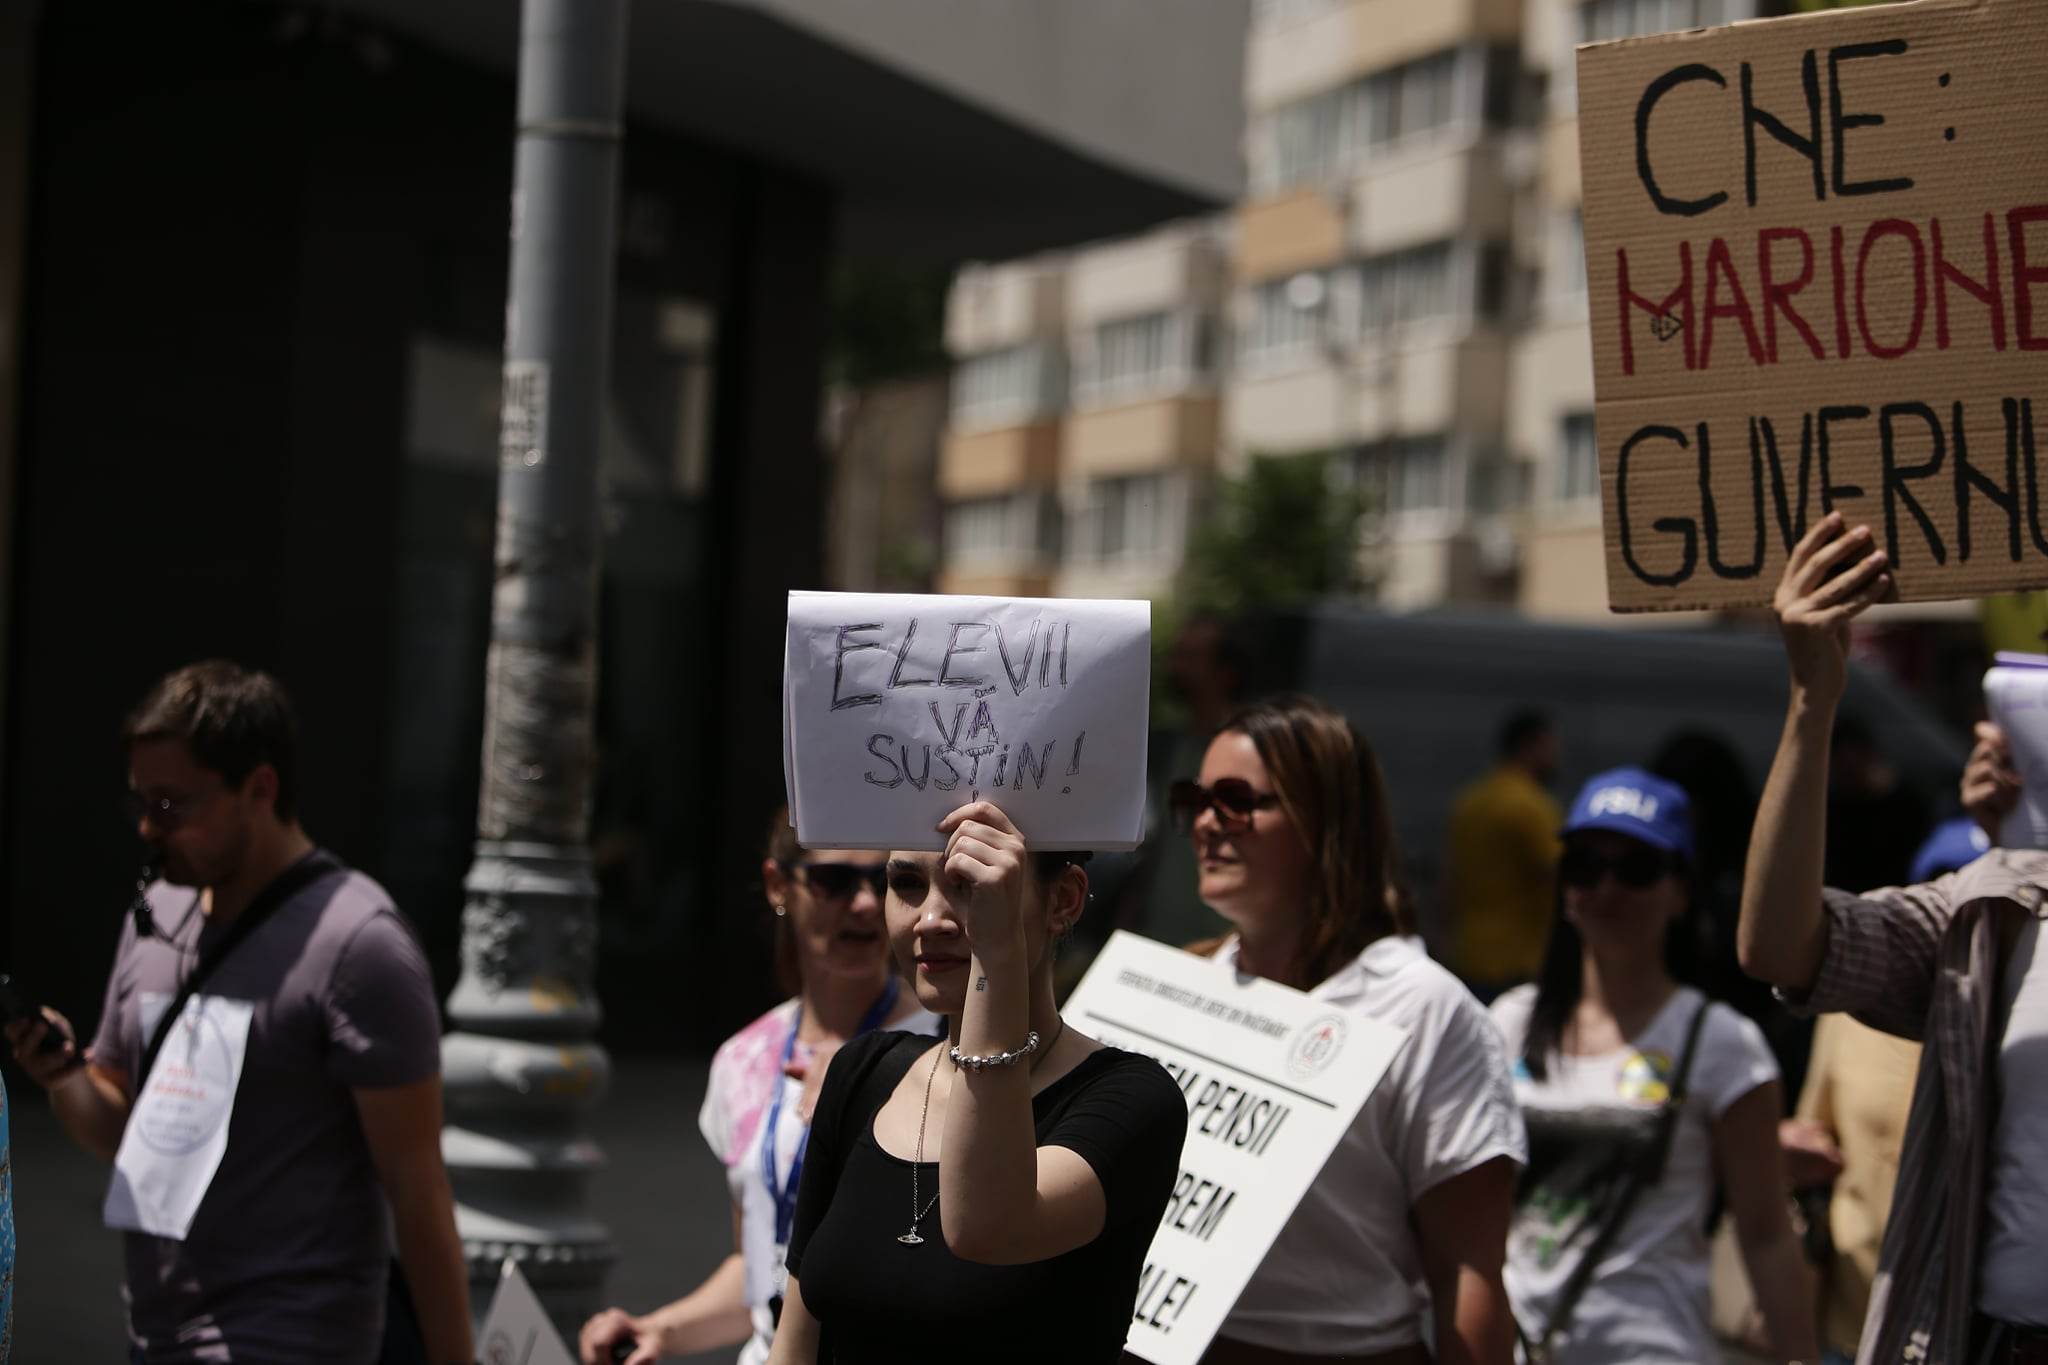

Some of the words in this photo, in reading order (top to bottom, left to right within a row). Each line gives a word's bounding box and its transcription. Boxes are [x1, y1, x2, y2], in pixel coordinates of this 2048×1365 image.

[832, 617, 1070, 711] ELEVII
[1190, 1079, 1291, 1156] PENSII
[1165, 1172, 1238, 1242] REM
